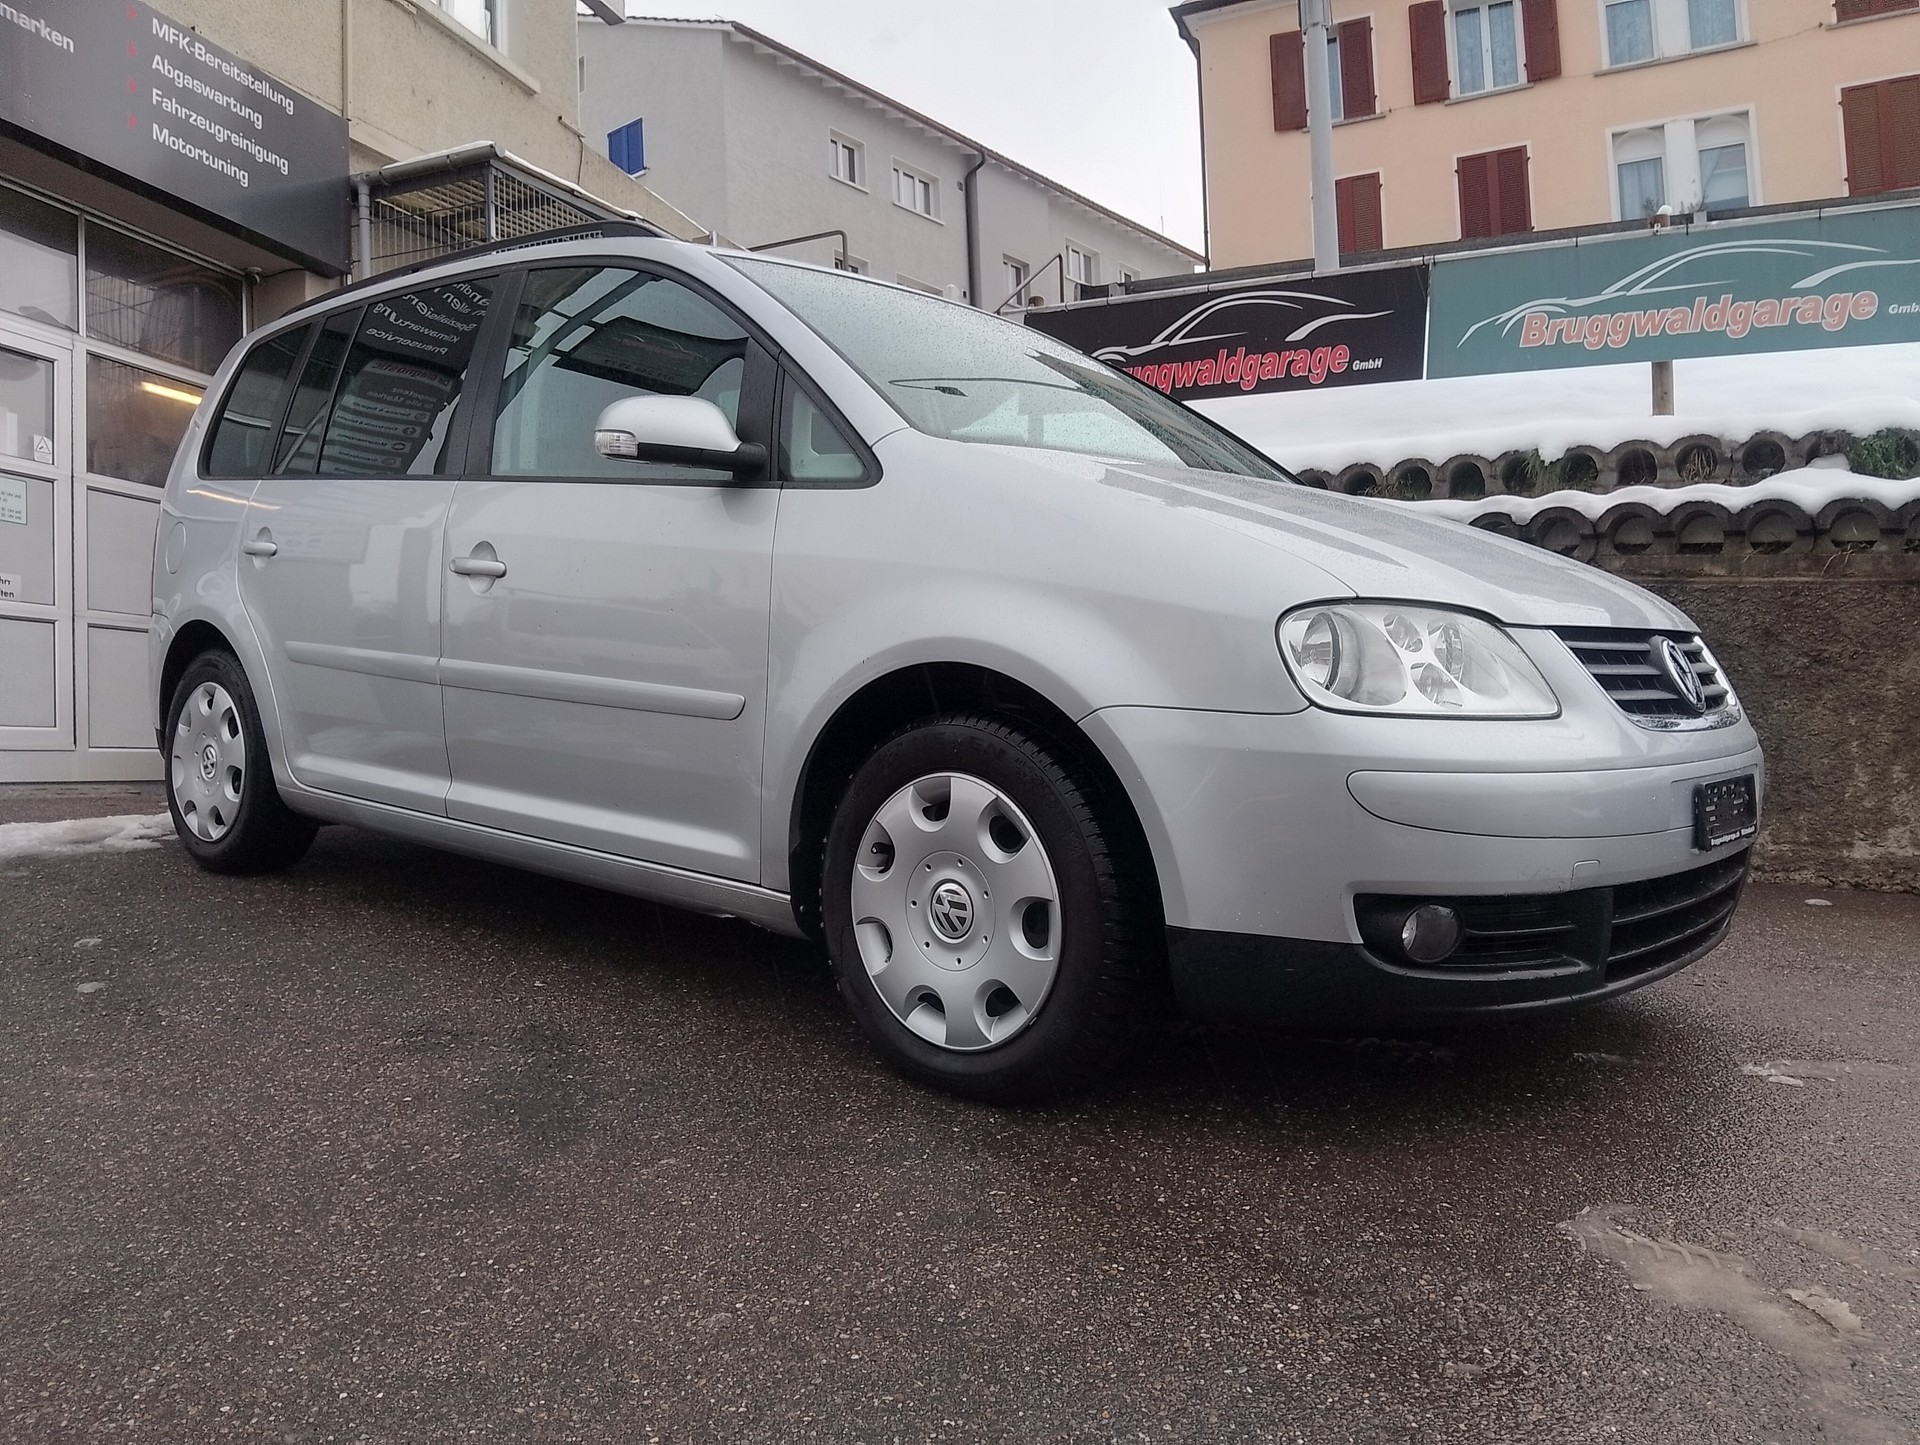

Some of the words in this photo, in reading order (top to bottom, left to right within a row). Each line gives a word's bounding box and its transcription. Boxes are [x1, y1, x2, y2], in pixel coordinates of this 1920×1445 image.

[151, 16, 295, 116] MFK-Bereitstellung
[151, 53, 263, 130] Abgaswartung
[151, 87, 289, 175] Fahrzeugreinigung
[151, 122, 249, 188] Motortuning
[1518, 289, 1880, 351] Bruggwaldgarage
[1888, 302, 1920, 314] Gmb
[1352, 357, 1384, 372] GmbH
